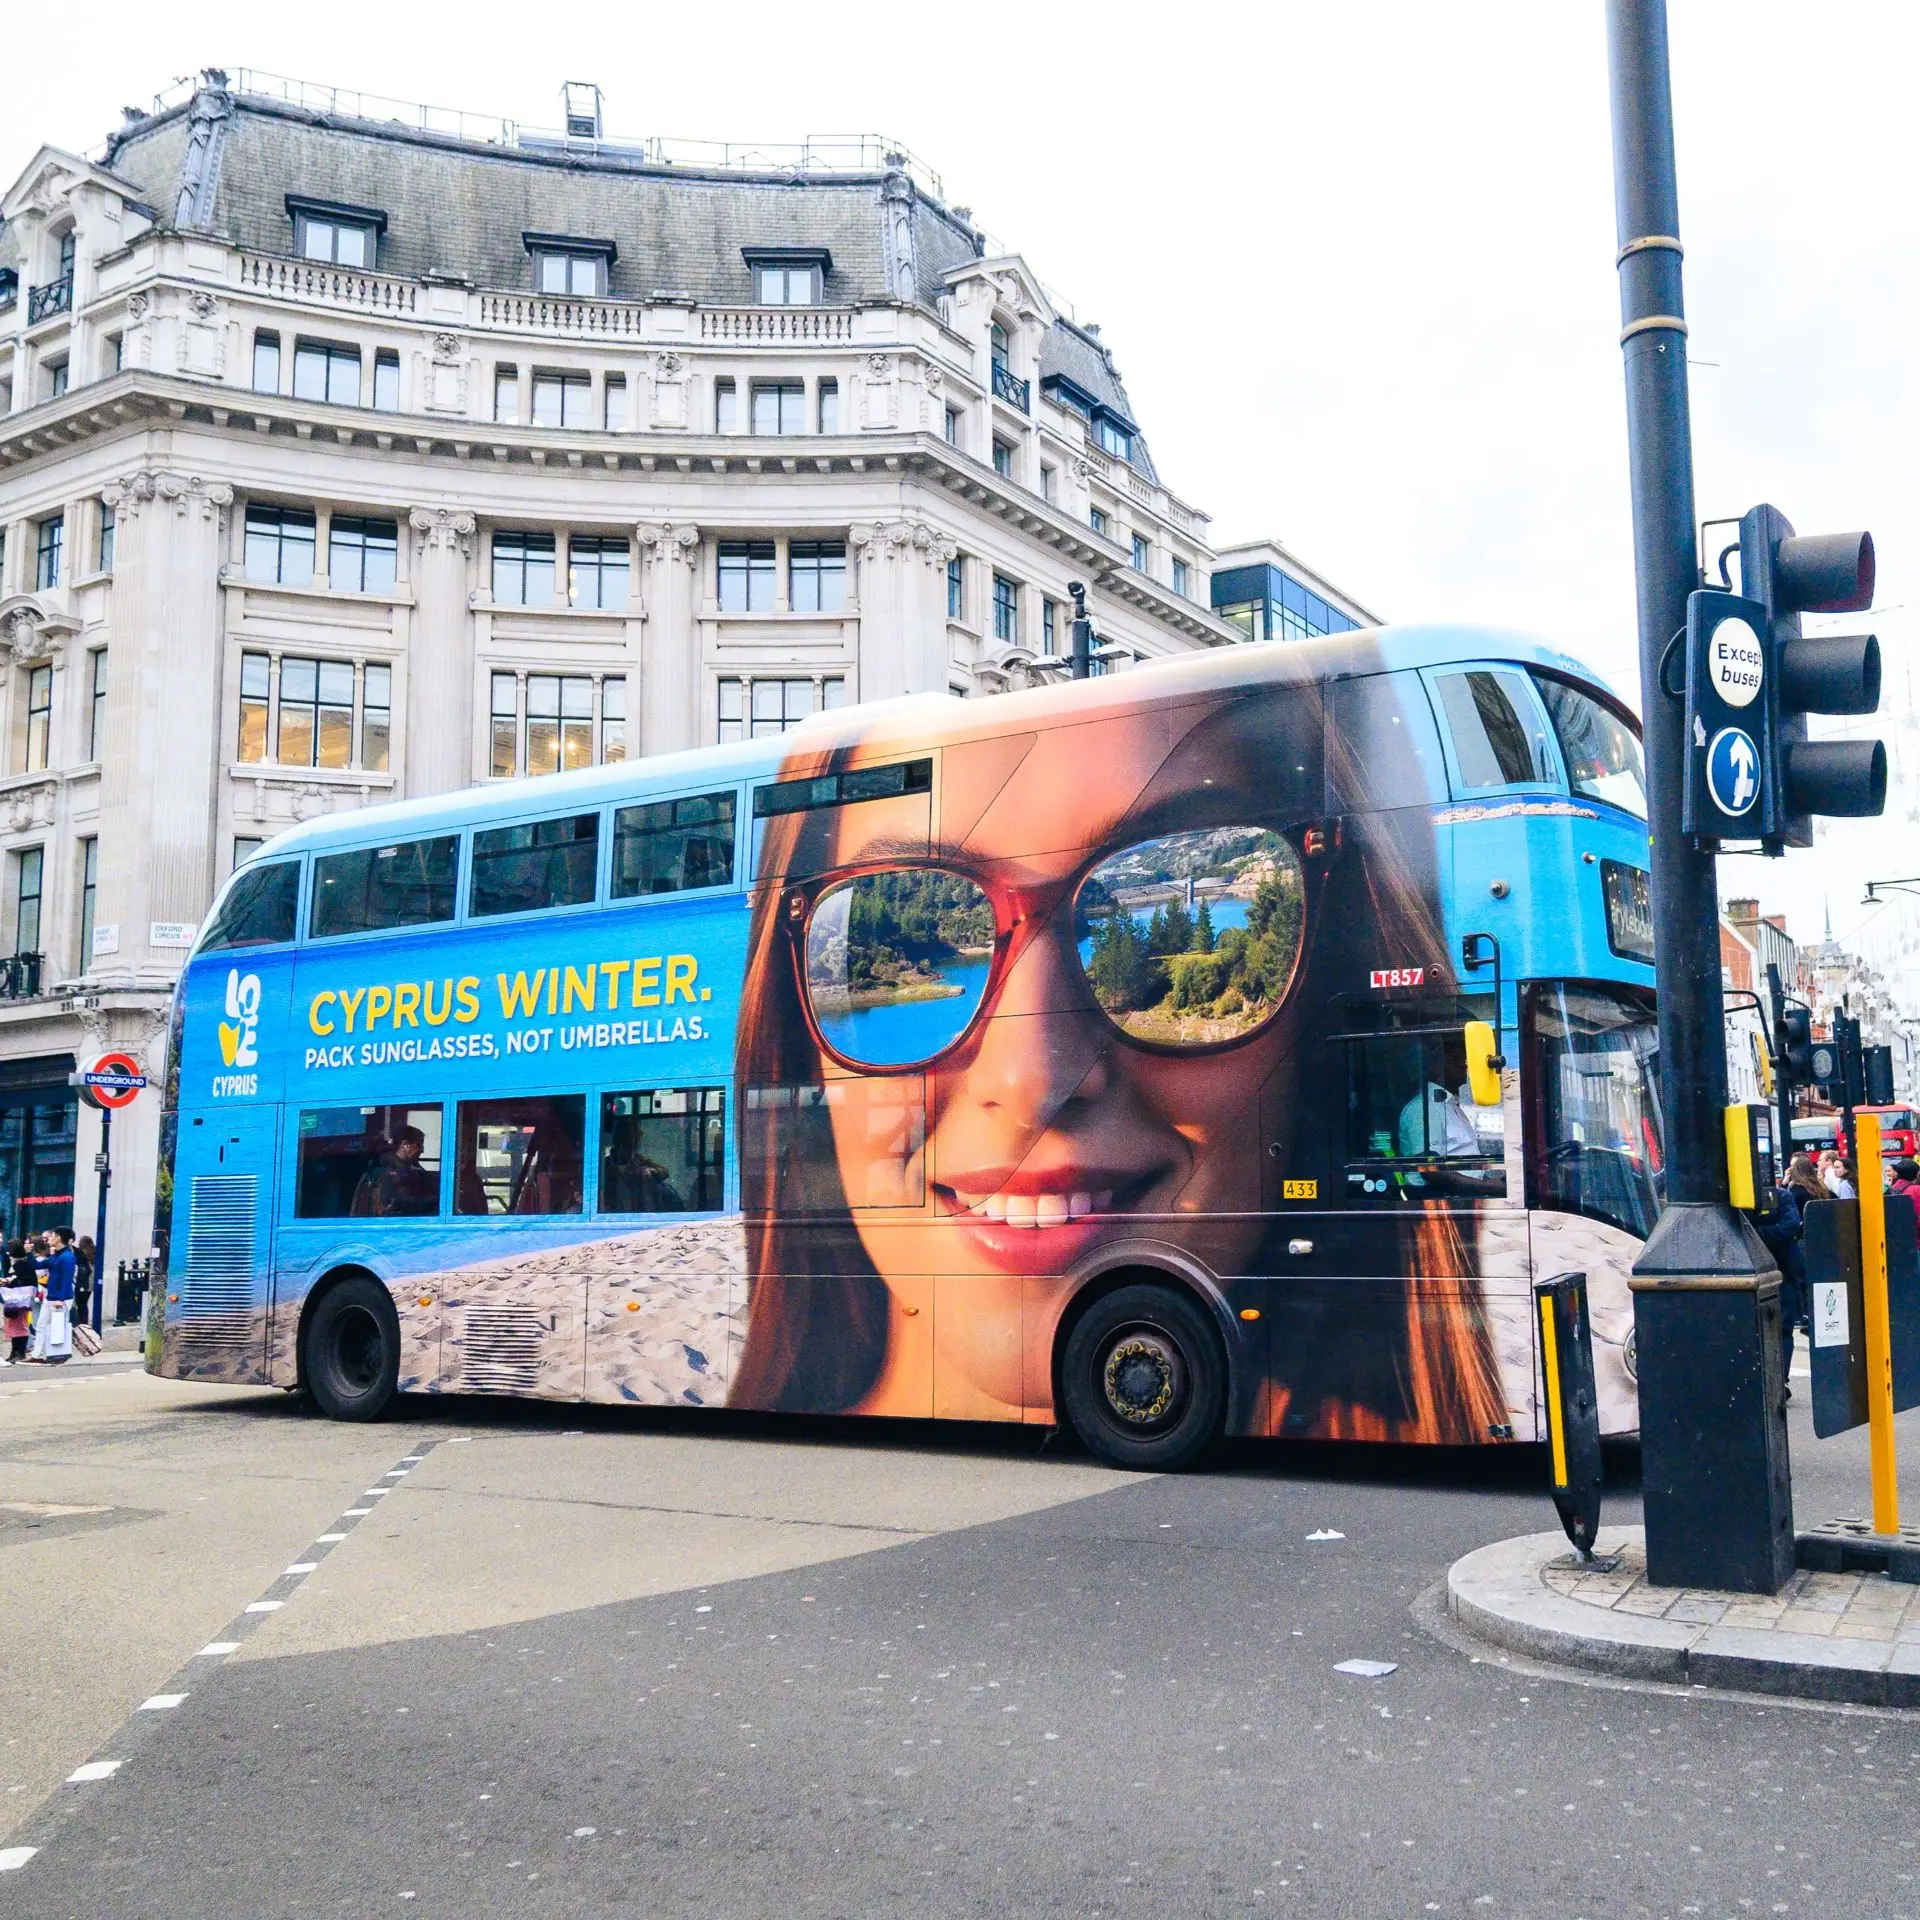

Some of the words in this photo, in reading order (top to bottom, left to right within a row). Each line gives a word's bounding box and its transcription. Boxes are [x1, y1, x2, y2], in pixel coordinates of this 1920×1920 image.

[1721, 664, 1759, 688] buses
[155, 924, 183, 932] OXFORD
[155, 932, 180, 940] CIRCUS
[1370, 967, 1424, 989] LT857
[309, 977, 480, 1036] CYPRUS
[498, 954, 712, 1019] WINTER.
[305, 1045, 355, 1068] PACK
[361, 1034, 500, 1066] SUNGLASSES,
[507, 1029, 552, 1053] NOT
[560, 1016, 710, 1048] UMBRELLAS.
[86, 1075, 146, 1086] UNDERGROUND
[212, 1073, 259, 1098] CYPRUS
[1804, 1143, 1816, 1151] 94
[1286, 1182, 1315, 1197] 433
